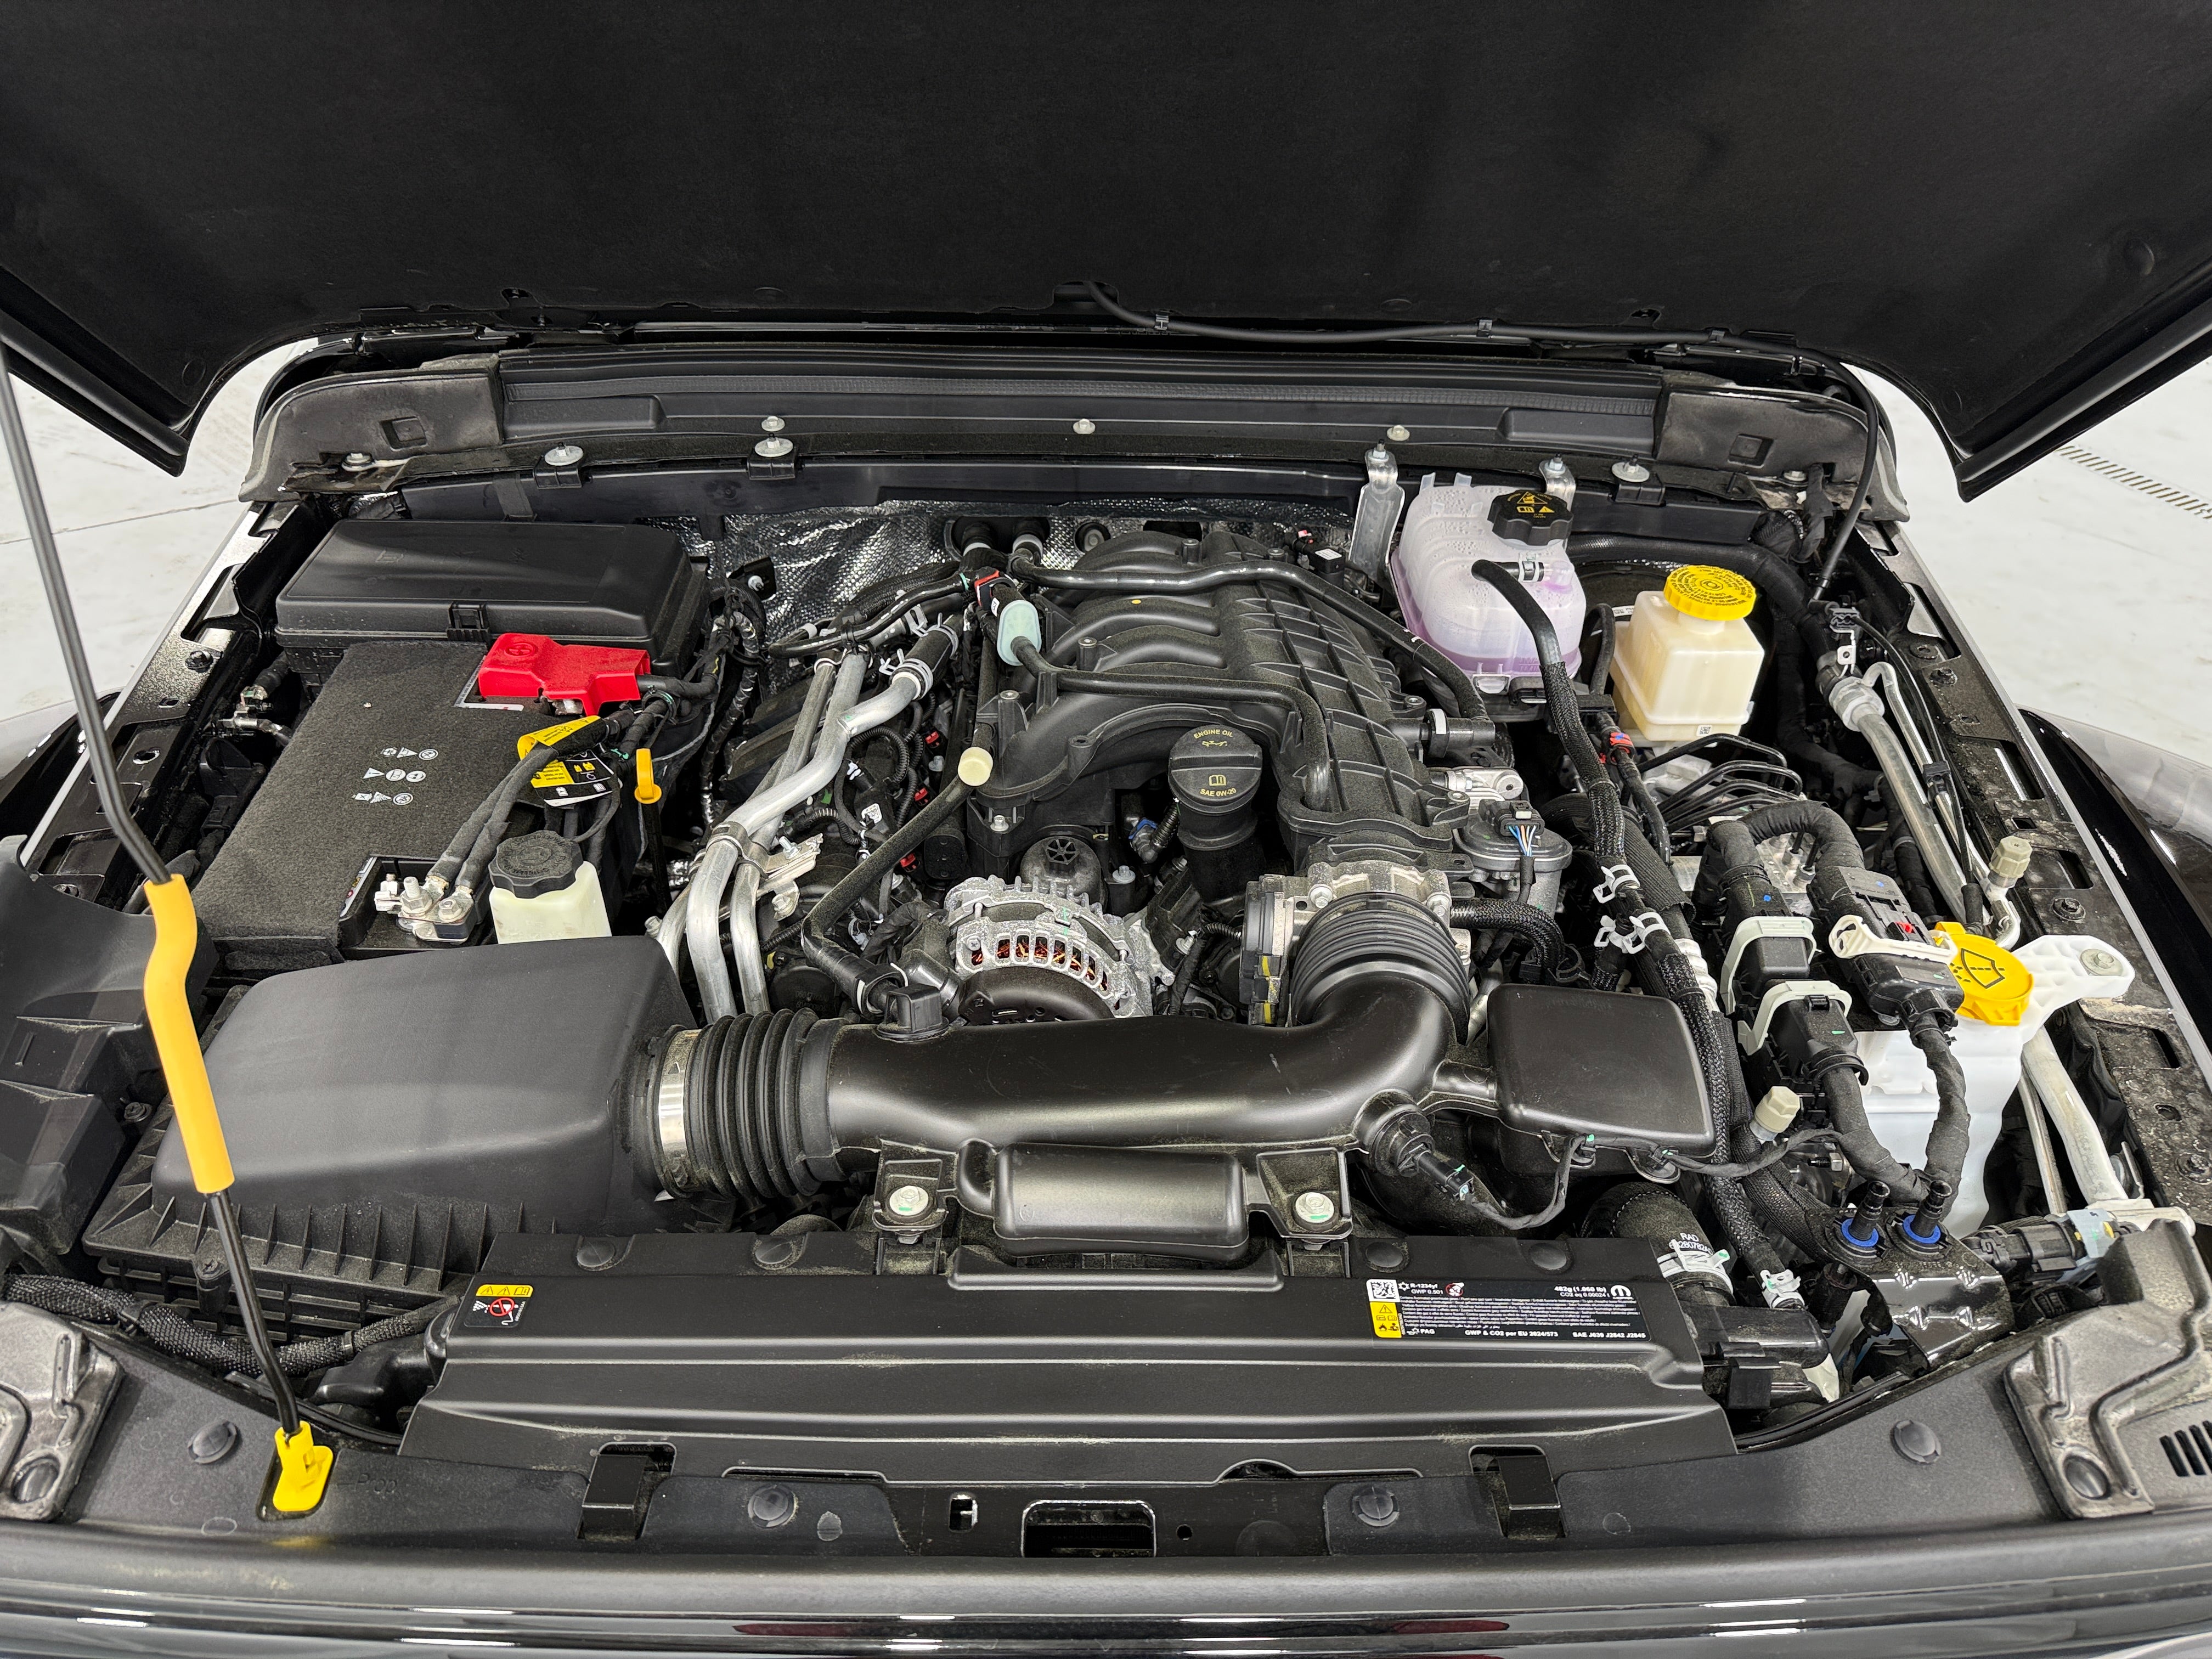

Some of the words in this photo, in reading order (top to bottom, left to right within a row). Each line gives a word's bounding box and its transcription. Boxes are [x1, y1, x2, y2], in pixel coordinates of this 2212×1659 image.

[1193, 729, 1221, 739] ENGINE
[1222, 730, 1233, 738] OIL
[1200, 788, 1215, 797] SAE
[1216, 787, 1237, 797] 0W-20
[1679, 1232, 1699, 1242] RAD
